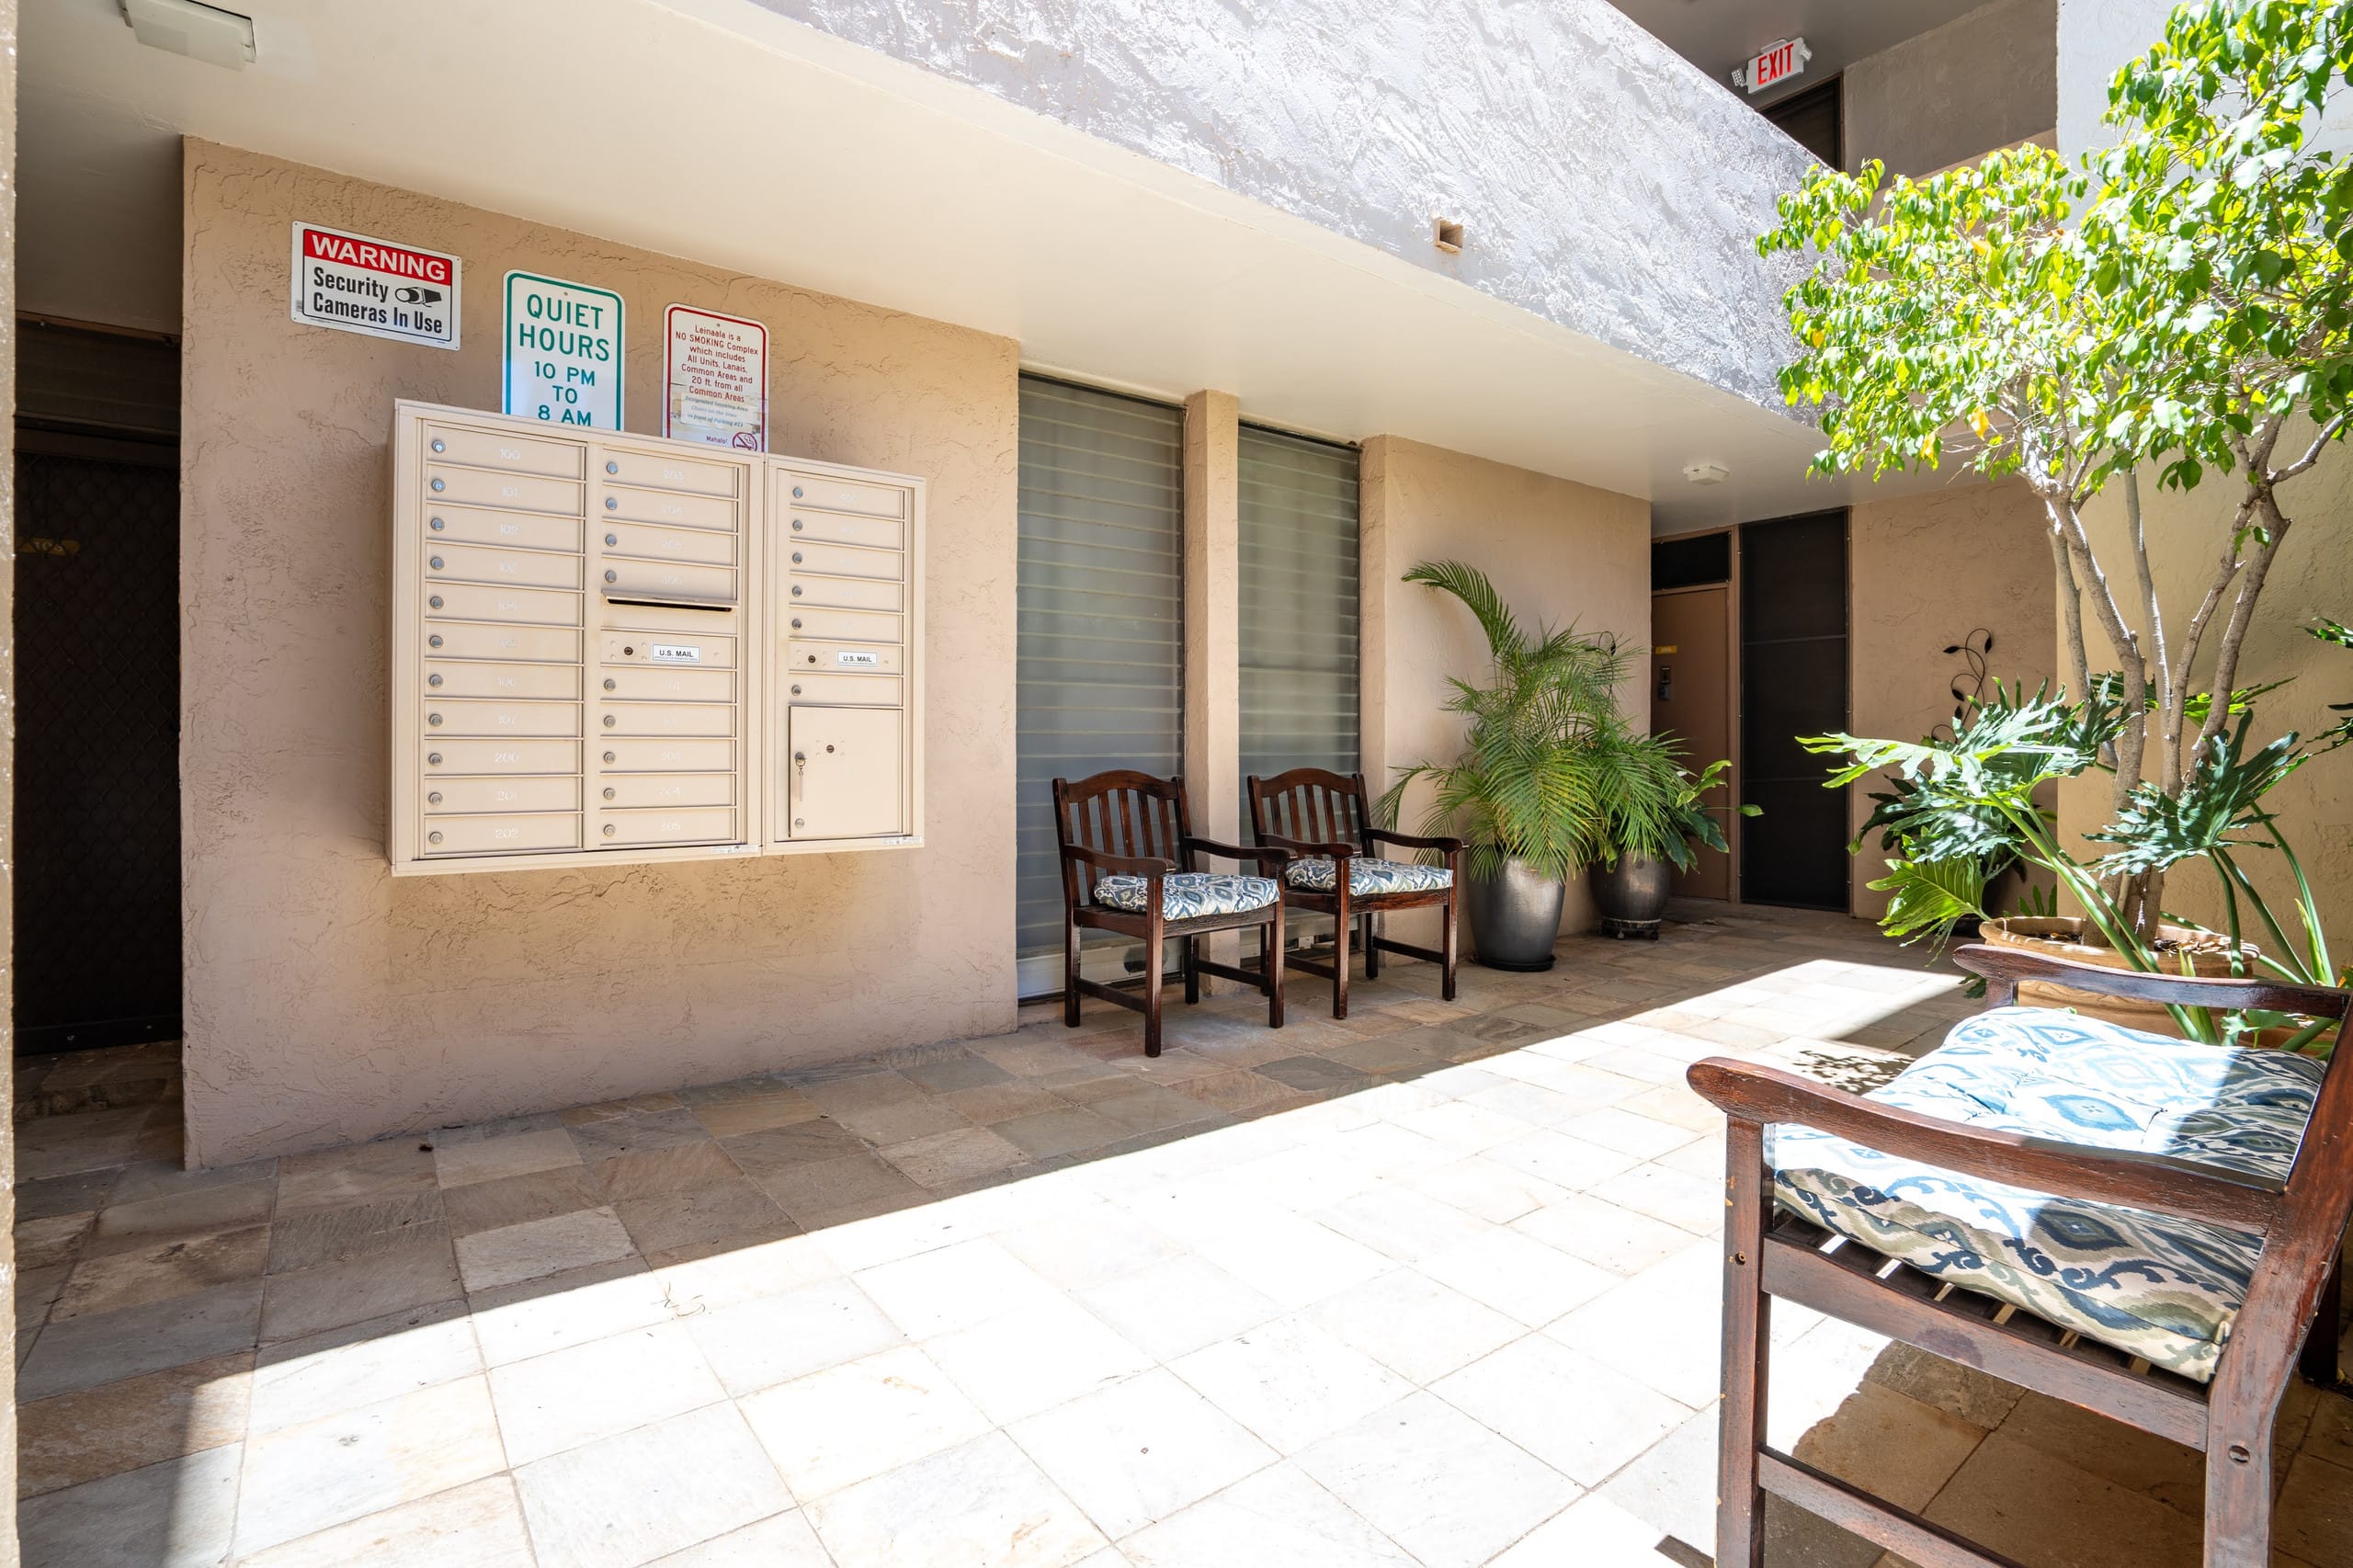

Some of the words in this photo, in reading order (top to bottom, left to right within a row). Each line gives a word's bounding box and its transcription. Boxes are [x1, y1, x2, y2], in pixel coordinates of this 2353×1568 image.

[1757, 43, 1795, 85] EXIT
[312, 234, 446, 281] WARNING
[313, 267, 389, 303] Security
[313, 292, 387, 324] Cameras
[393, 307, 408, 327] In
[414, 311, 442, 334] Use
[527, 293, 604, 330] QUIET
[519, 323, 609, 362] HOURS
[695, 324, 726, 338] Leinaala
[676, 331, 687, 340] NO
[689, 335, 724, 348] SMOKING
[727, 342, 758, 355] Complex
[689, 346, 712, 356] which
[715, 349, 745, 363] includes
[688, 355, 697, 363] All
[535, 360, 556, 379] 10
[566, 366, 596, 386] PM
[681, 363, 714, 376] Common
[717, 370, 737, 381] Areas
[552, 385, 578, 403] TO
[689, 385, 722, 399] Common
[724, 392, 745, 403] Areas
[691, 376, 702, 384] 20
[714, 380, 732, 391] from
[734, 384, 744, 392] all
[538, 404, 551, 420] 8
[561, 408, 592, 426] AM
